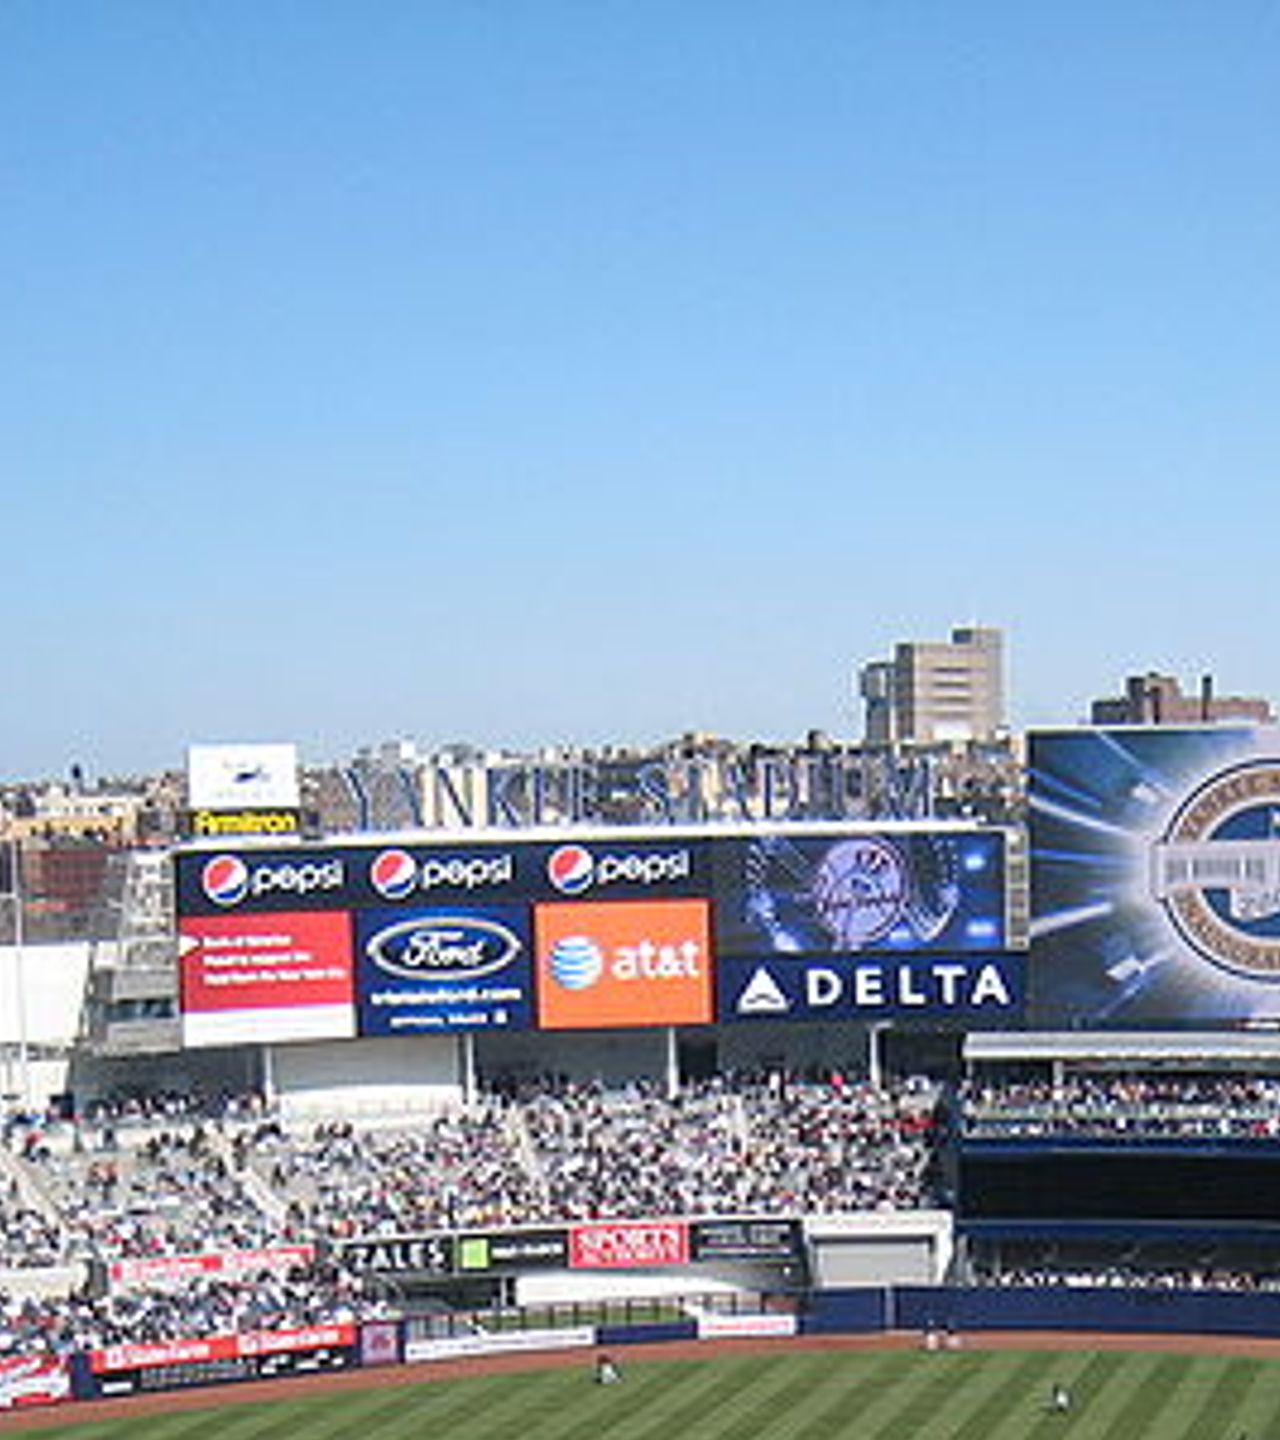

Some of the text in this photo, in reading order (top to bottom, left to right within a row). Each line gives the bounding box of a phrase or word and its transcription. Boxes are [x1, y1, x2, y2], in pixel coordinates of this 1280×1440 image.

[251, 860, 344, 895] pepsi
[421, 855, 512, 891] pepsi
[596, 850, 691, 885] pepsi
[401, 931, 486, 966] Ford
[611, 940, 700, 978] at&t
[807, 965, 1010, 1005] DELTA
[354, 1239, 445, 1269] ZALES
